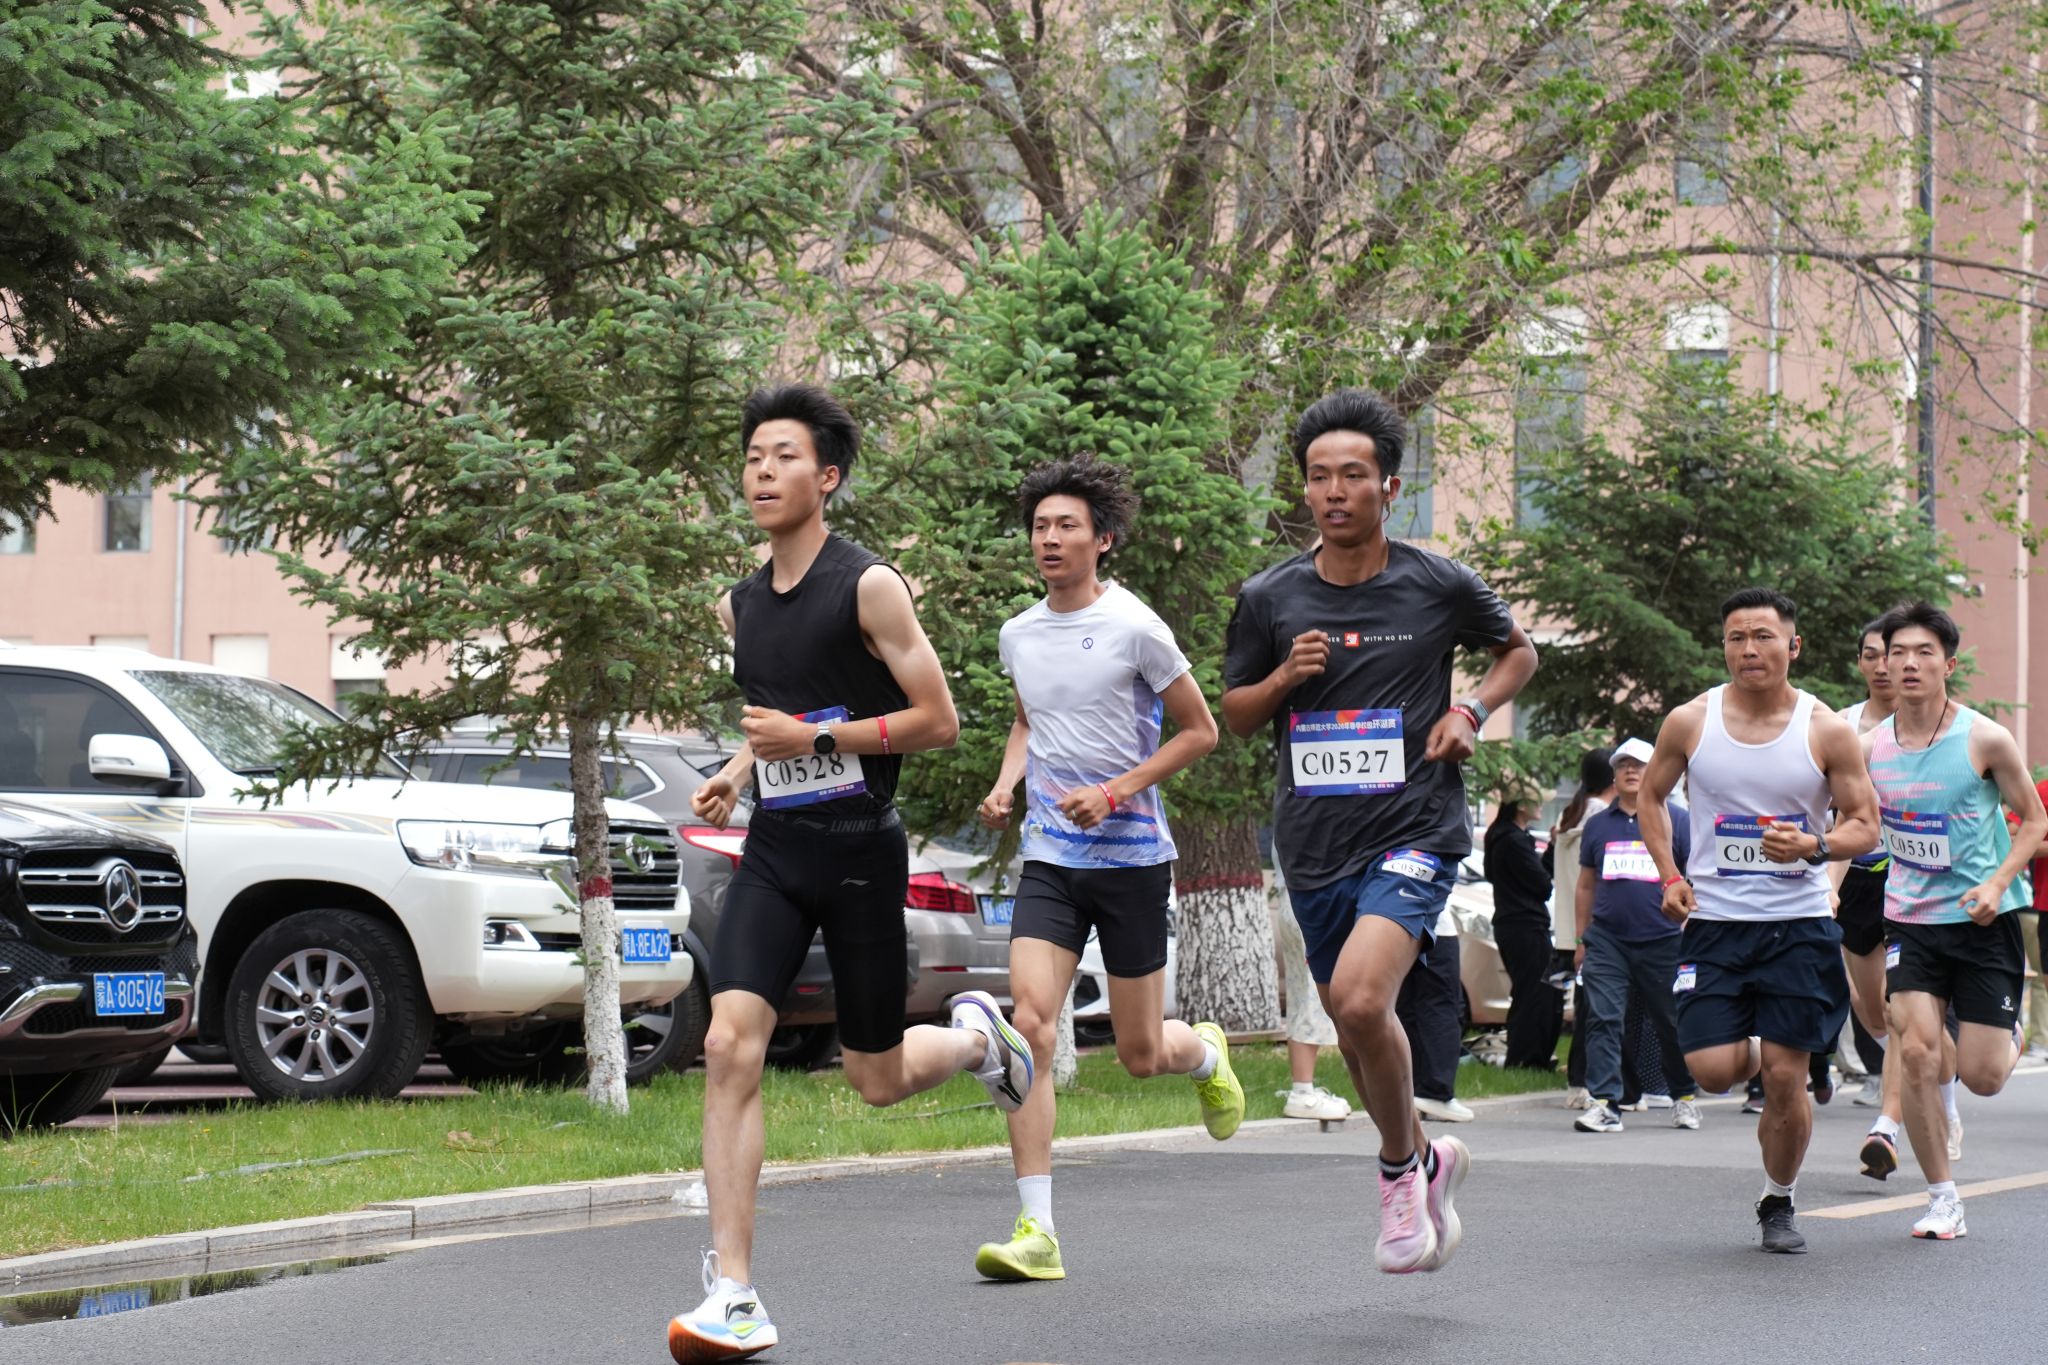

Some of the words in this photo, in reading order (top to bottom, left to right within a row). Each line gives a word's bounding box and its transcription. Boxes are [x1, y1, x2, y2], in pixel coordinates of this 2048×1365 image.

[764, 752, 845, 787] C0528
[1301, 750, 1389, 776] C0527
[829, 819, 876, 833] LINING
[1890, 834, 1940, 859] C0530
